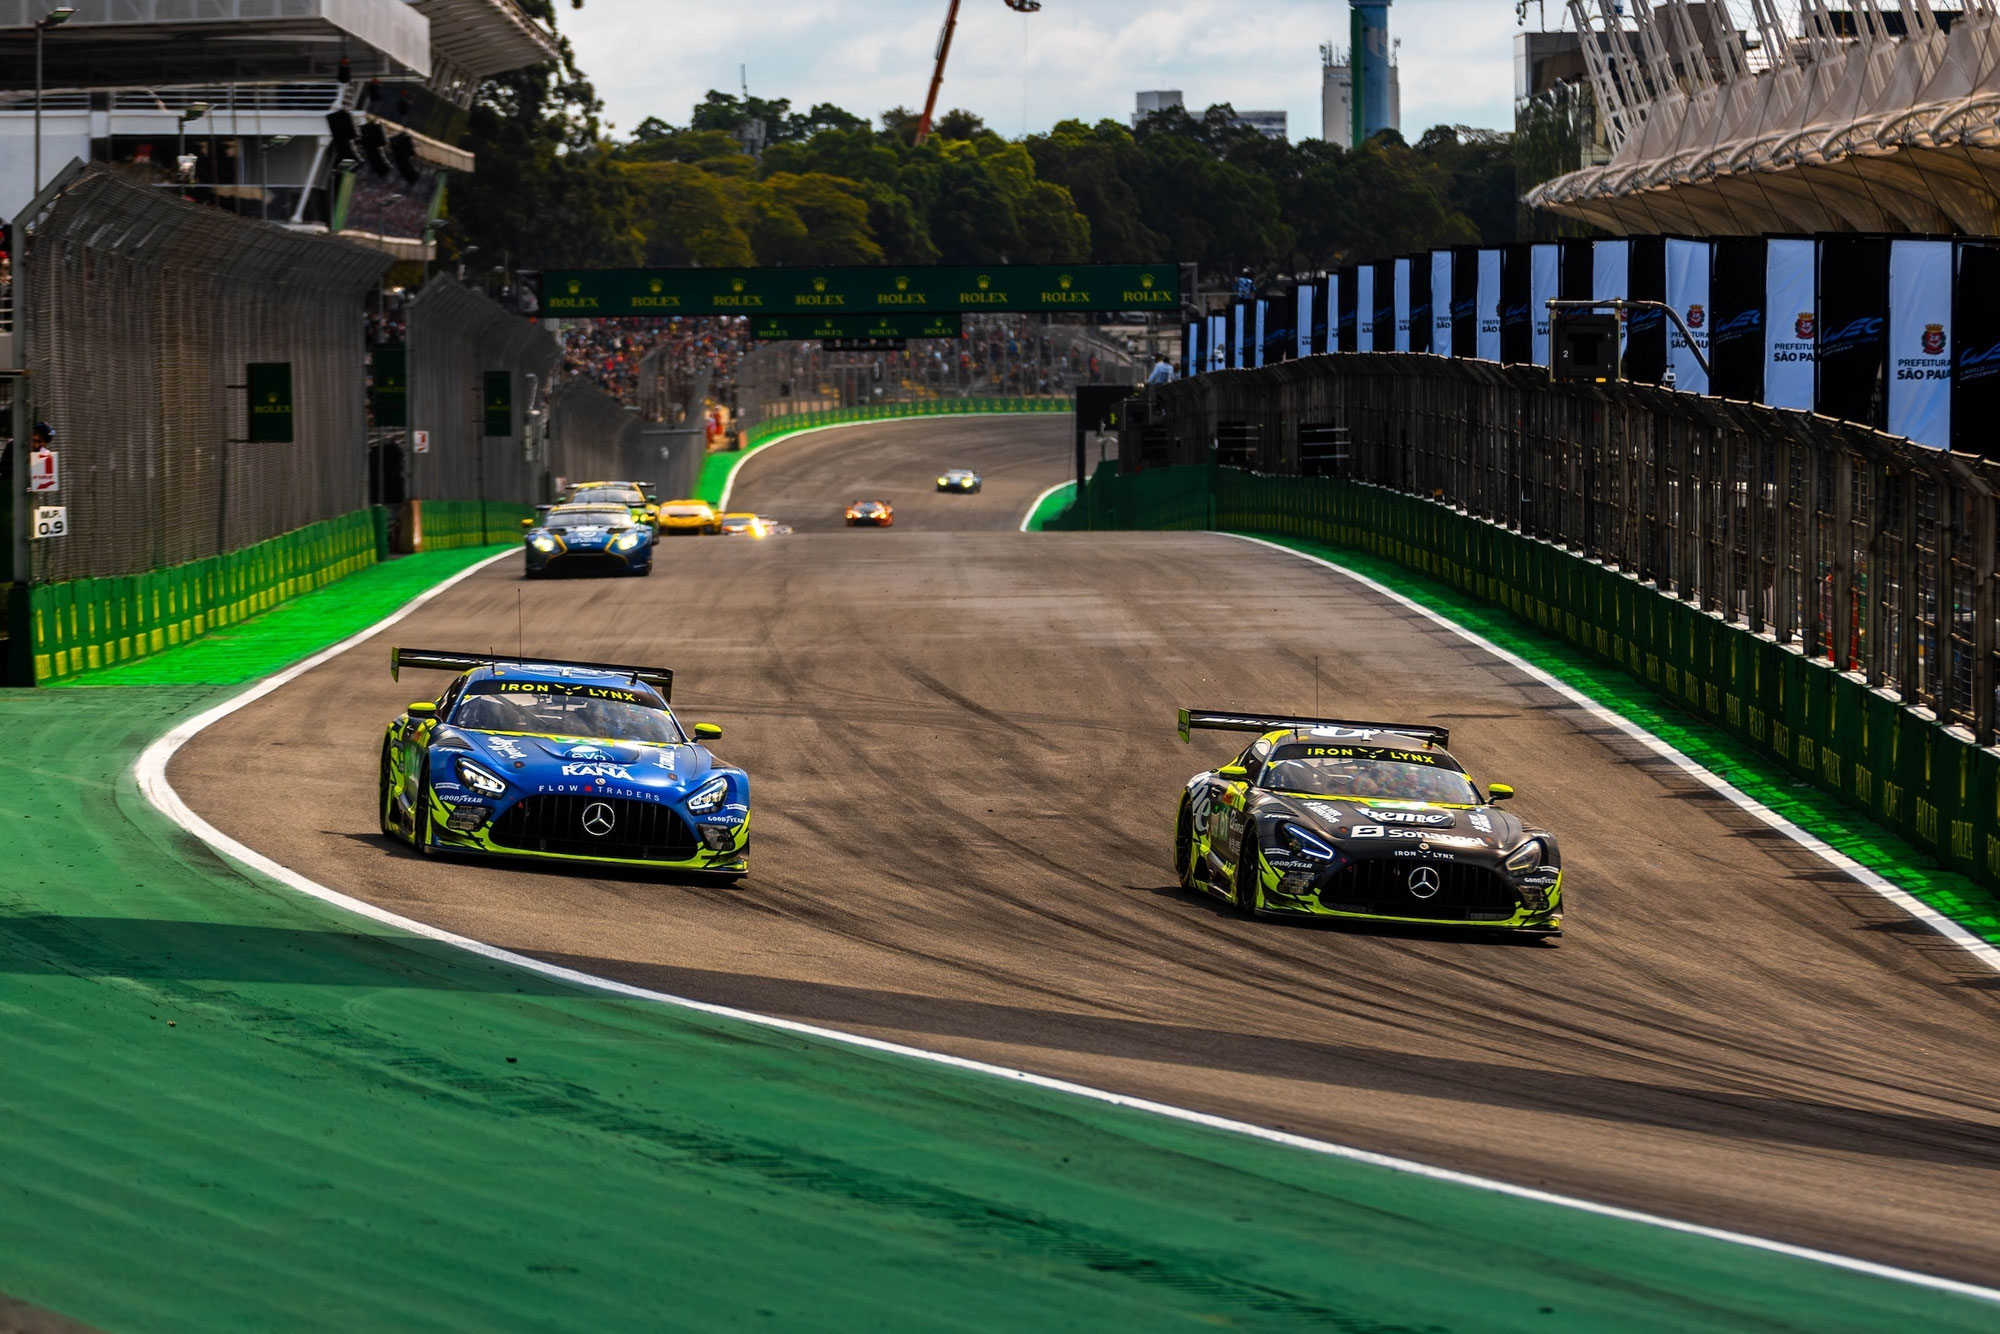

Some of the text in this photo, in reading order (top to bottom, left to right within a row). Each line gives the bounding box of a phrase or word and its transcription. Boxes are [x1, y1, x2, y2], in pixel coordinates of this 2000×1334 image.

[550, 297, 599, 308] ROLEX
[631, 296, 681, 307] ROLEX
[713, 296, 763, 306] ROLEX
[795, 294, 845, 306] ROLEX
[877, 294, 927, 304] ROLEX
[960, 292, 1008, 304] ROLEX
[1041, 292, 1090, 303] ROLEX
[1123, 291, 1172, 302] ROLEX
[1822, 317, 1883, 344] WEC
[1774, 351, 1798, 362] SÃO
[1897, 368, 1924, 380] SÃO
[39, 521, 64, 535] 0.9
[500, 683, 636, 702] IRON LYNX
[1390, 752, 1435, 764] LYNX
[562, 766, 634, 781] RANA
[439, 794, 482, 804] GOODYEAR
[597, 786, 660, 802] TRADERS
[707, 815, 744, 824] GOODYEAR
[1355, 808, 1448, 823] beme
[1388, 829, 1488, 847] Sonangol
[1269, 860, 1312, 868] GOODYEAR
